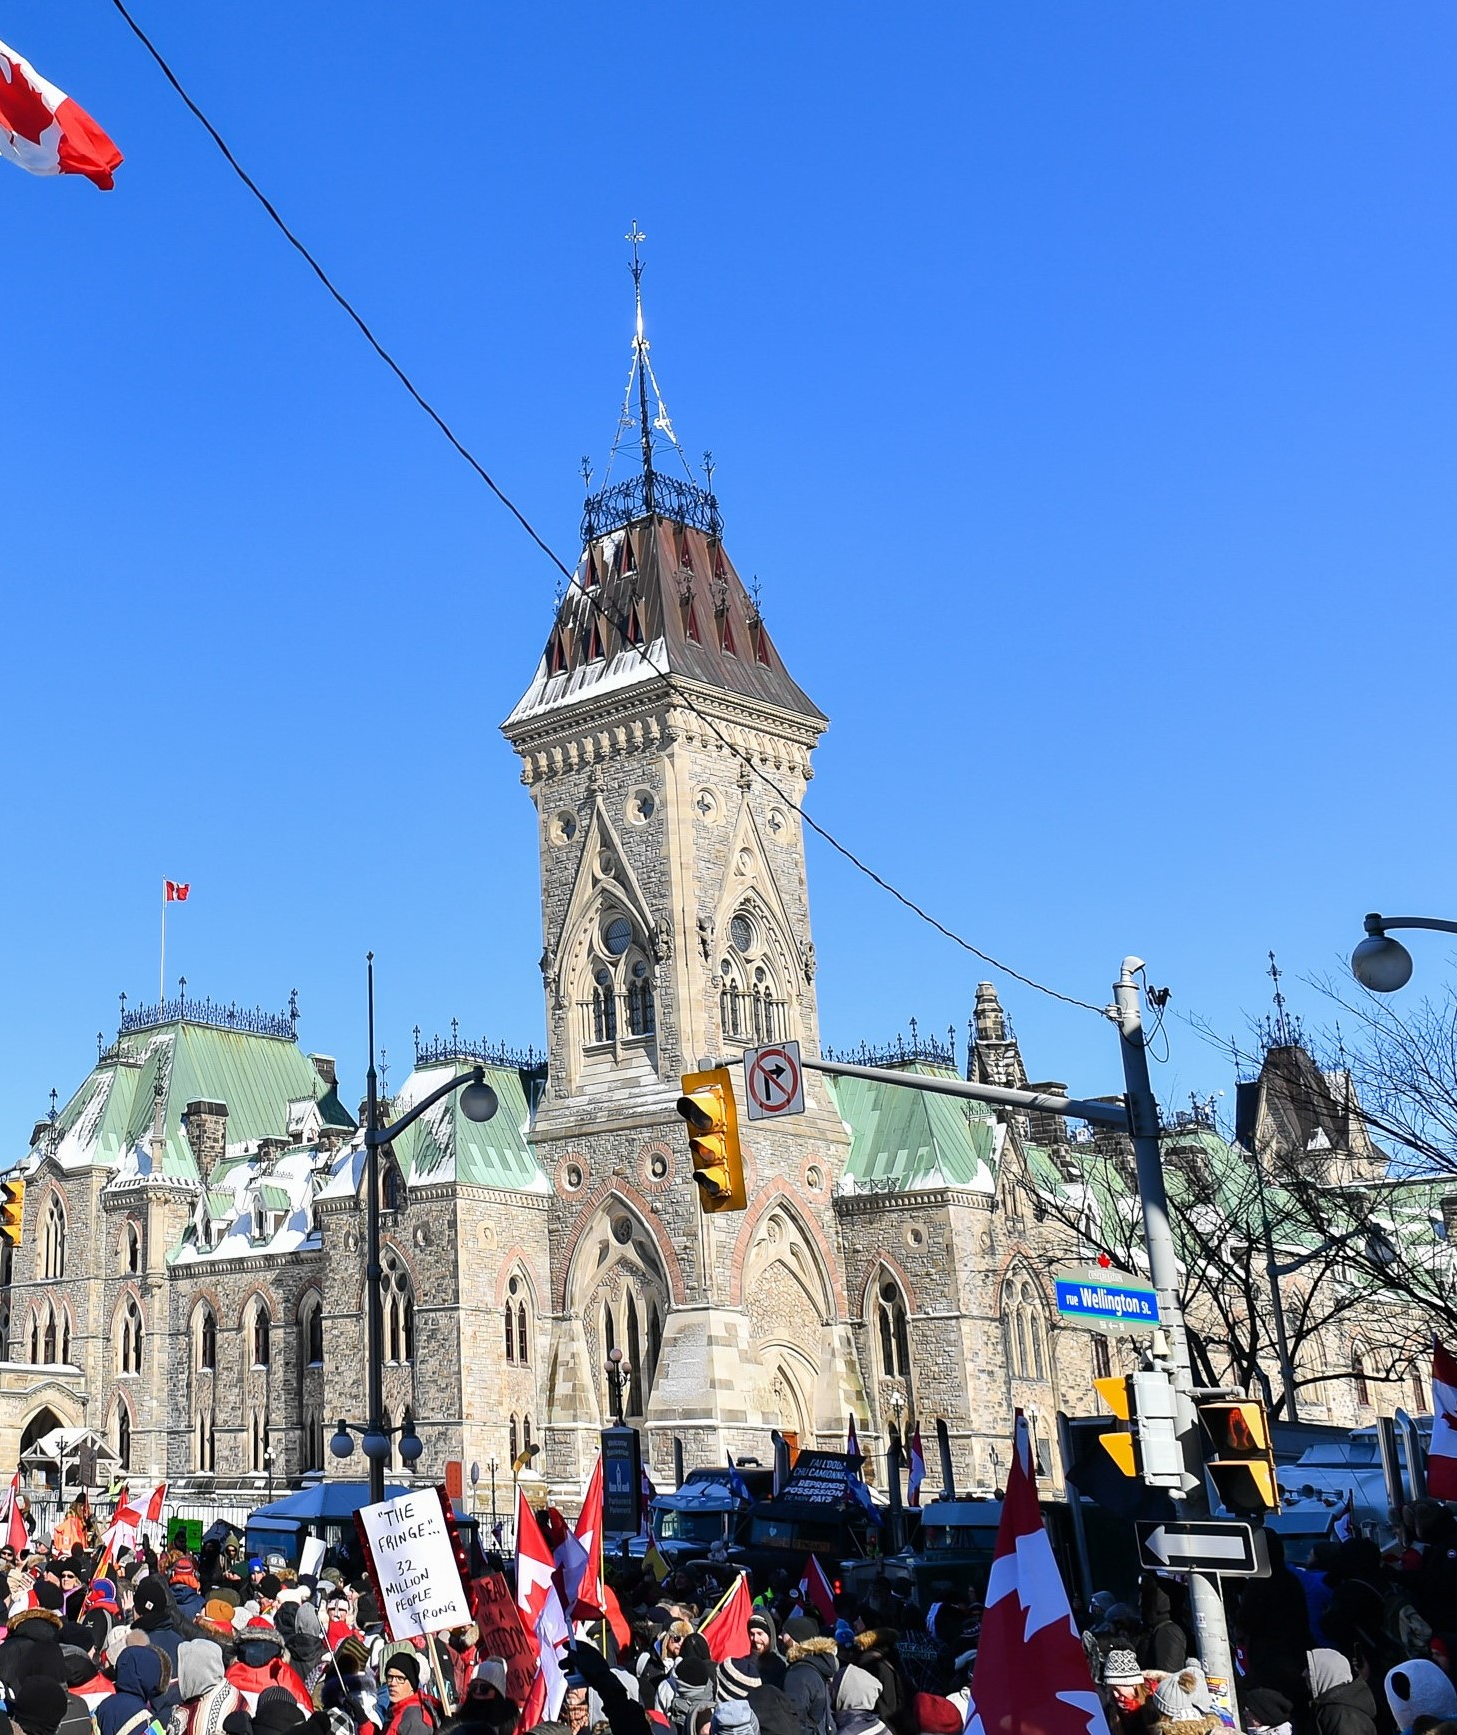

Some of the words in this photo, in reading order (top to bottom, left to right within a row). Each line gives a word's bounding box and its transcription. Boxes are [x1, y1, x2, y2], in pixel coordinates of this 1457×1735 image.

[1065, 1294, 1079, 1306] rue
[1079, 1287, 1140, 1317] Wellington
[798, 1480, 845, 1489] REPRENDS
[809, 1468, 847, 1480] CAMIONNE
[784, 1487, 844, 1497] POSSESSION
[396, 1559, 417, 1577] 32
[385, 1567, 430, 1597] MILLION
[395, 1588, 432, 1614] PEOPLE
[409, 1601, 457, 1625] STRONG
